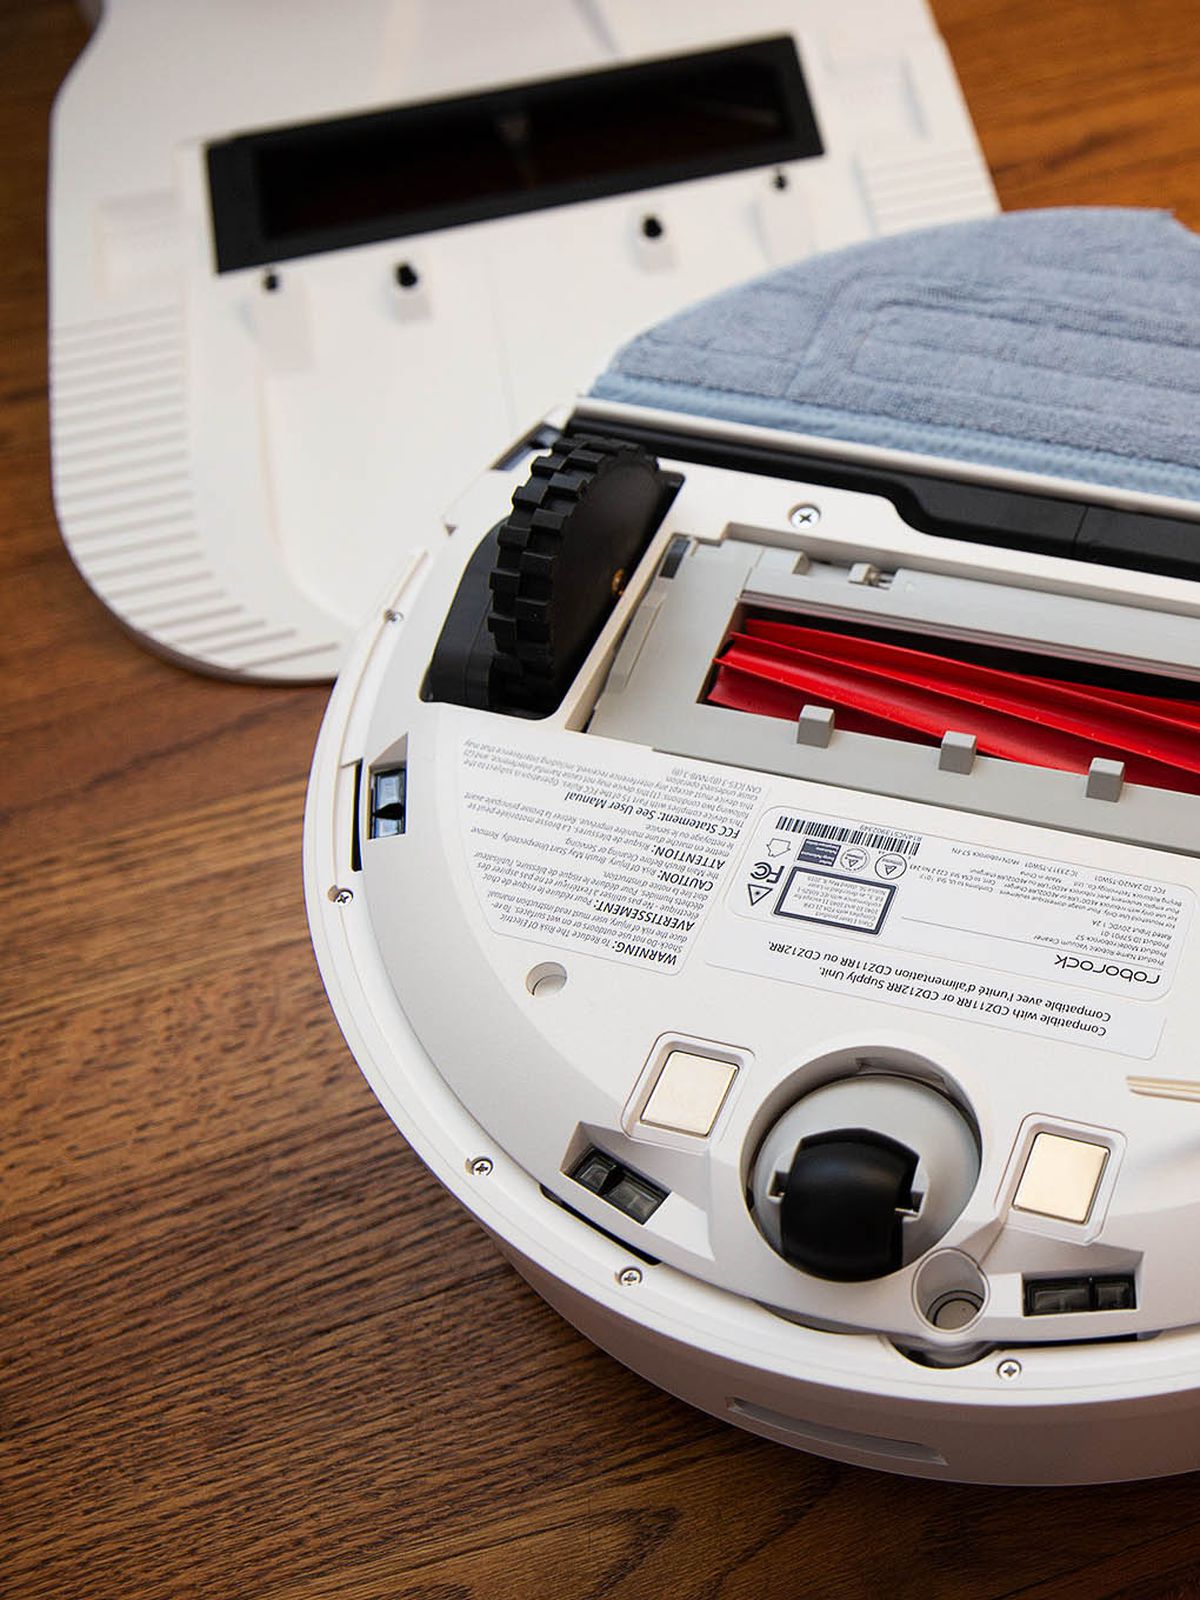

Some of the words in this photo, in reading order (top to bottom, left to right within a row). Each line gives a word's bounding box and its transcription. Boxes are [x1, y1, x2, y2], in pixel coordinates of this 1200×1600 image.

[563, 790, 607, 808] Manual
[606, 800, 634, 814] User
[633, 806, 656, 819] See
[655, 811, 718, 833] Statement:
[717, 825, 740, 838] FCC
[611, 835, 623, 844] de
[622, 836, 651, 850] Risque
[566, 846, 585, 858] May
[582, 852, 606, 864] Brush
[649, 844, 726, 869] ATTENTION:
[475, 861, 491, 871] des
[629, 863, 641, 871] Of
[640, 865, 657, 875] Risk
[519, 869, 535, 879] pas
[546, 868, 558, 877] de
[499, 877, 512, 886] de
[510, 878, 538, 892] risque
[543, 877, 554, 885] et
[655, 869, 715, 891] CAUTION:
[535, 886, 545, 894] le
[543, 887, 574, 901] réduire
[619, 885, 639, 895] Pour
[513, 896, 554, 912] instruction
[572, 894, 593, 905] Pour
[627, 894, 643, 904] pas
[500, 904, 512, 912] To
[513, 907, 546, 920] surfaces.
[553, 906, 572, 916] read
[498, 913, 528, 927] Electric
[545, 914, 561, 924] wet
[570, 910, 591, 920] must
[591, 899, 695, 931] AVERTISSEMENT:
[591, 914, 608, 923] user
[526, 920, 538, 929] Of
[537, 923, 555, 933] Risk
[581, 922, 617, 937] outdoors
[630, 924, 641, 932] of
[640, 926, 655, 935] risk
[554, 927, 570, 937] The
[570, 931, 600, 944] Reduce
[654, 929, 668, 938] the
[667, 932, 688, 943] duce
[599, 938, 611, 946] To
[630, 934, 646, 944] not
[1142, 938, 1169, 948] Product
[609, 940, 679, 965] WARNING:
[766, 941, 821, 961] CDZ12RR.
[1139, 946, 1167, 957] Product
[823, 953, 838, 962] ou
[1136, 955, 1164, 965] Product
[839, 956, 892, 976] CDZ11RR
[1052, 953, 1160, 987] roborock
[817, 967, 844, 981] Unit.
[845, 971, 885, 989] Supply
[894, 968, 976, 993] d'alimentation
[885, 981, 939, 1001] CDZ12RR
[977, 985, 1014, 1001] l'unité
[941, 993, 954, 1002] or
[1016, 993, 1043, 1005] avec
[955, 996, 1010, 1016] CDZ11RR
[1043, 997, 1112, 1022] Compatible
[1011, 1008, 1038, 1022] with
[1038, 1011, 1107, 1036] Compatible
